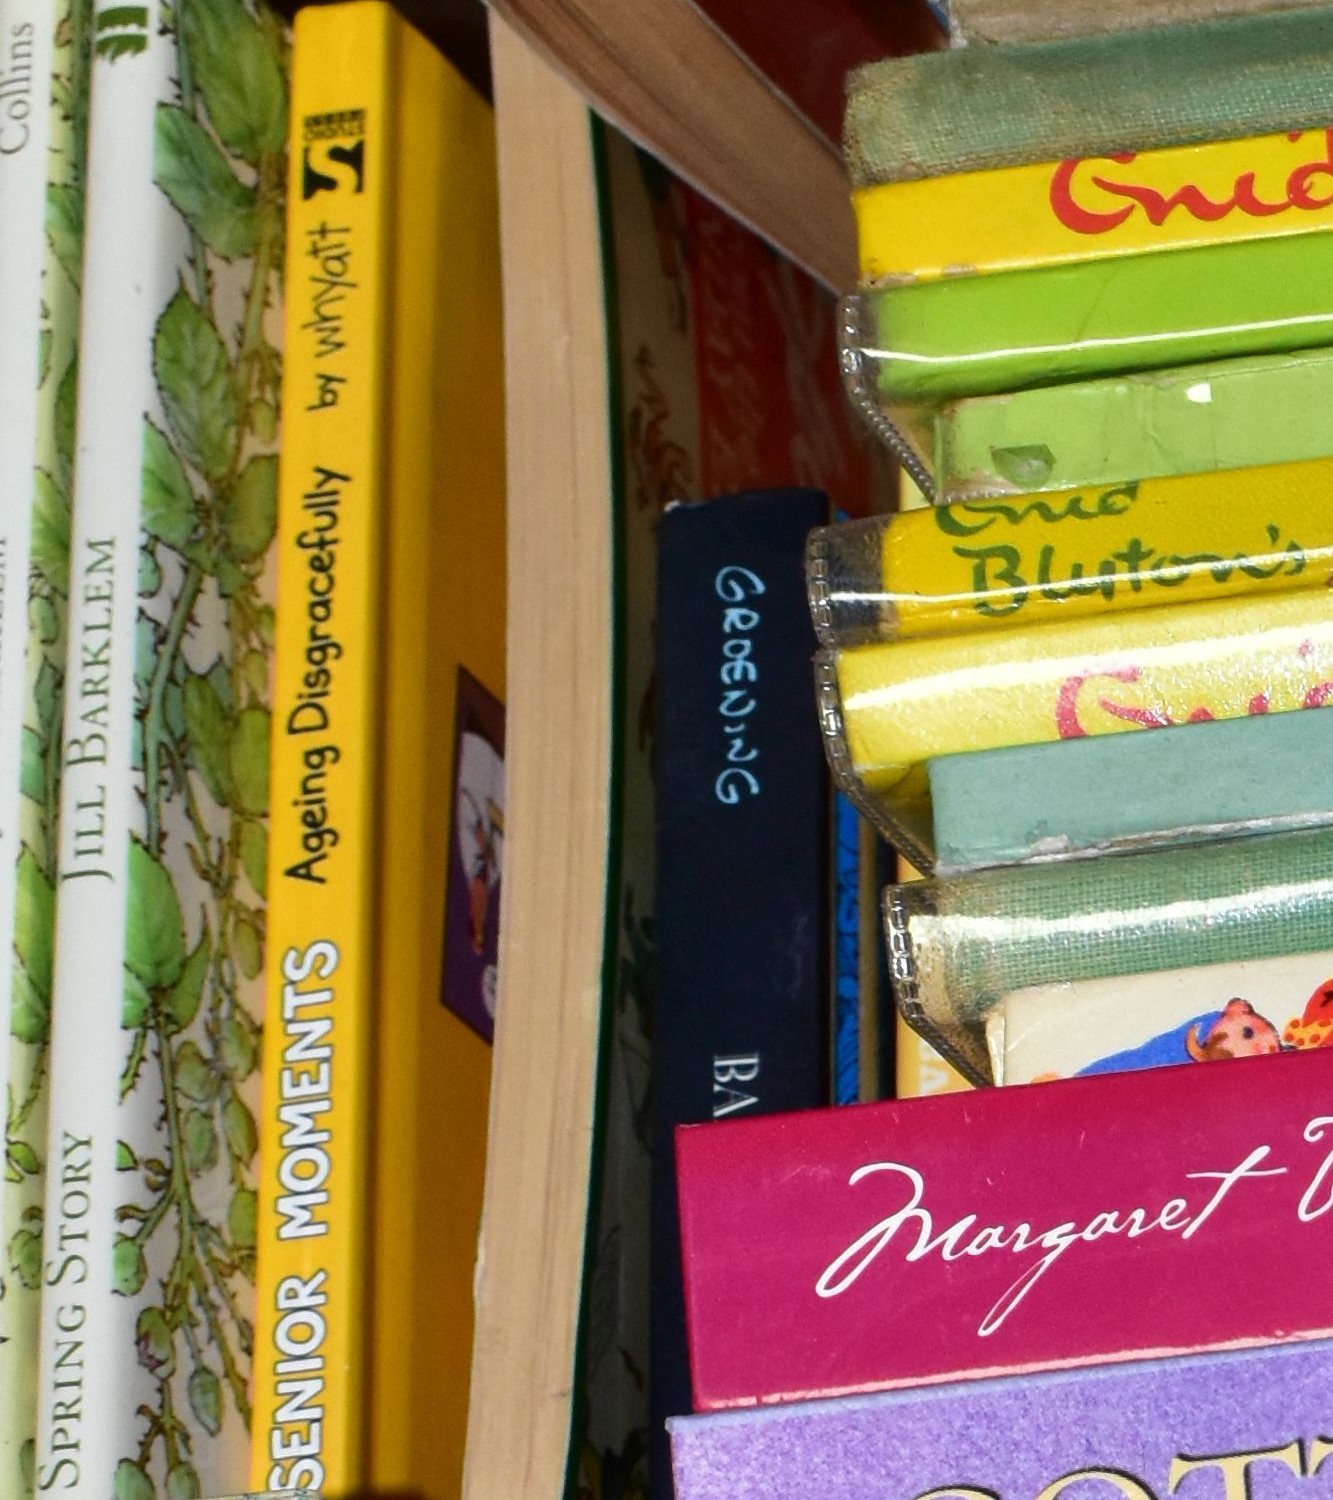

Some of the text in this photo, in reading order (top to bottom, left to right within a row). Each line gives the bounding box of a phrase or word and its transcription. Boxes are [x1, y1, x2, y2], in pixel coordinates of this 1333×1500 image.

[38, 535, 118, 1492] SPRING STORY JILL BARKLEM
[268, 216, 355, 1494] SENIOR MOMENTS Ageing Disgracefully by whyatt
[817, 1147, 1287, 1336] Margaret
